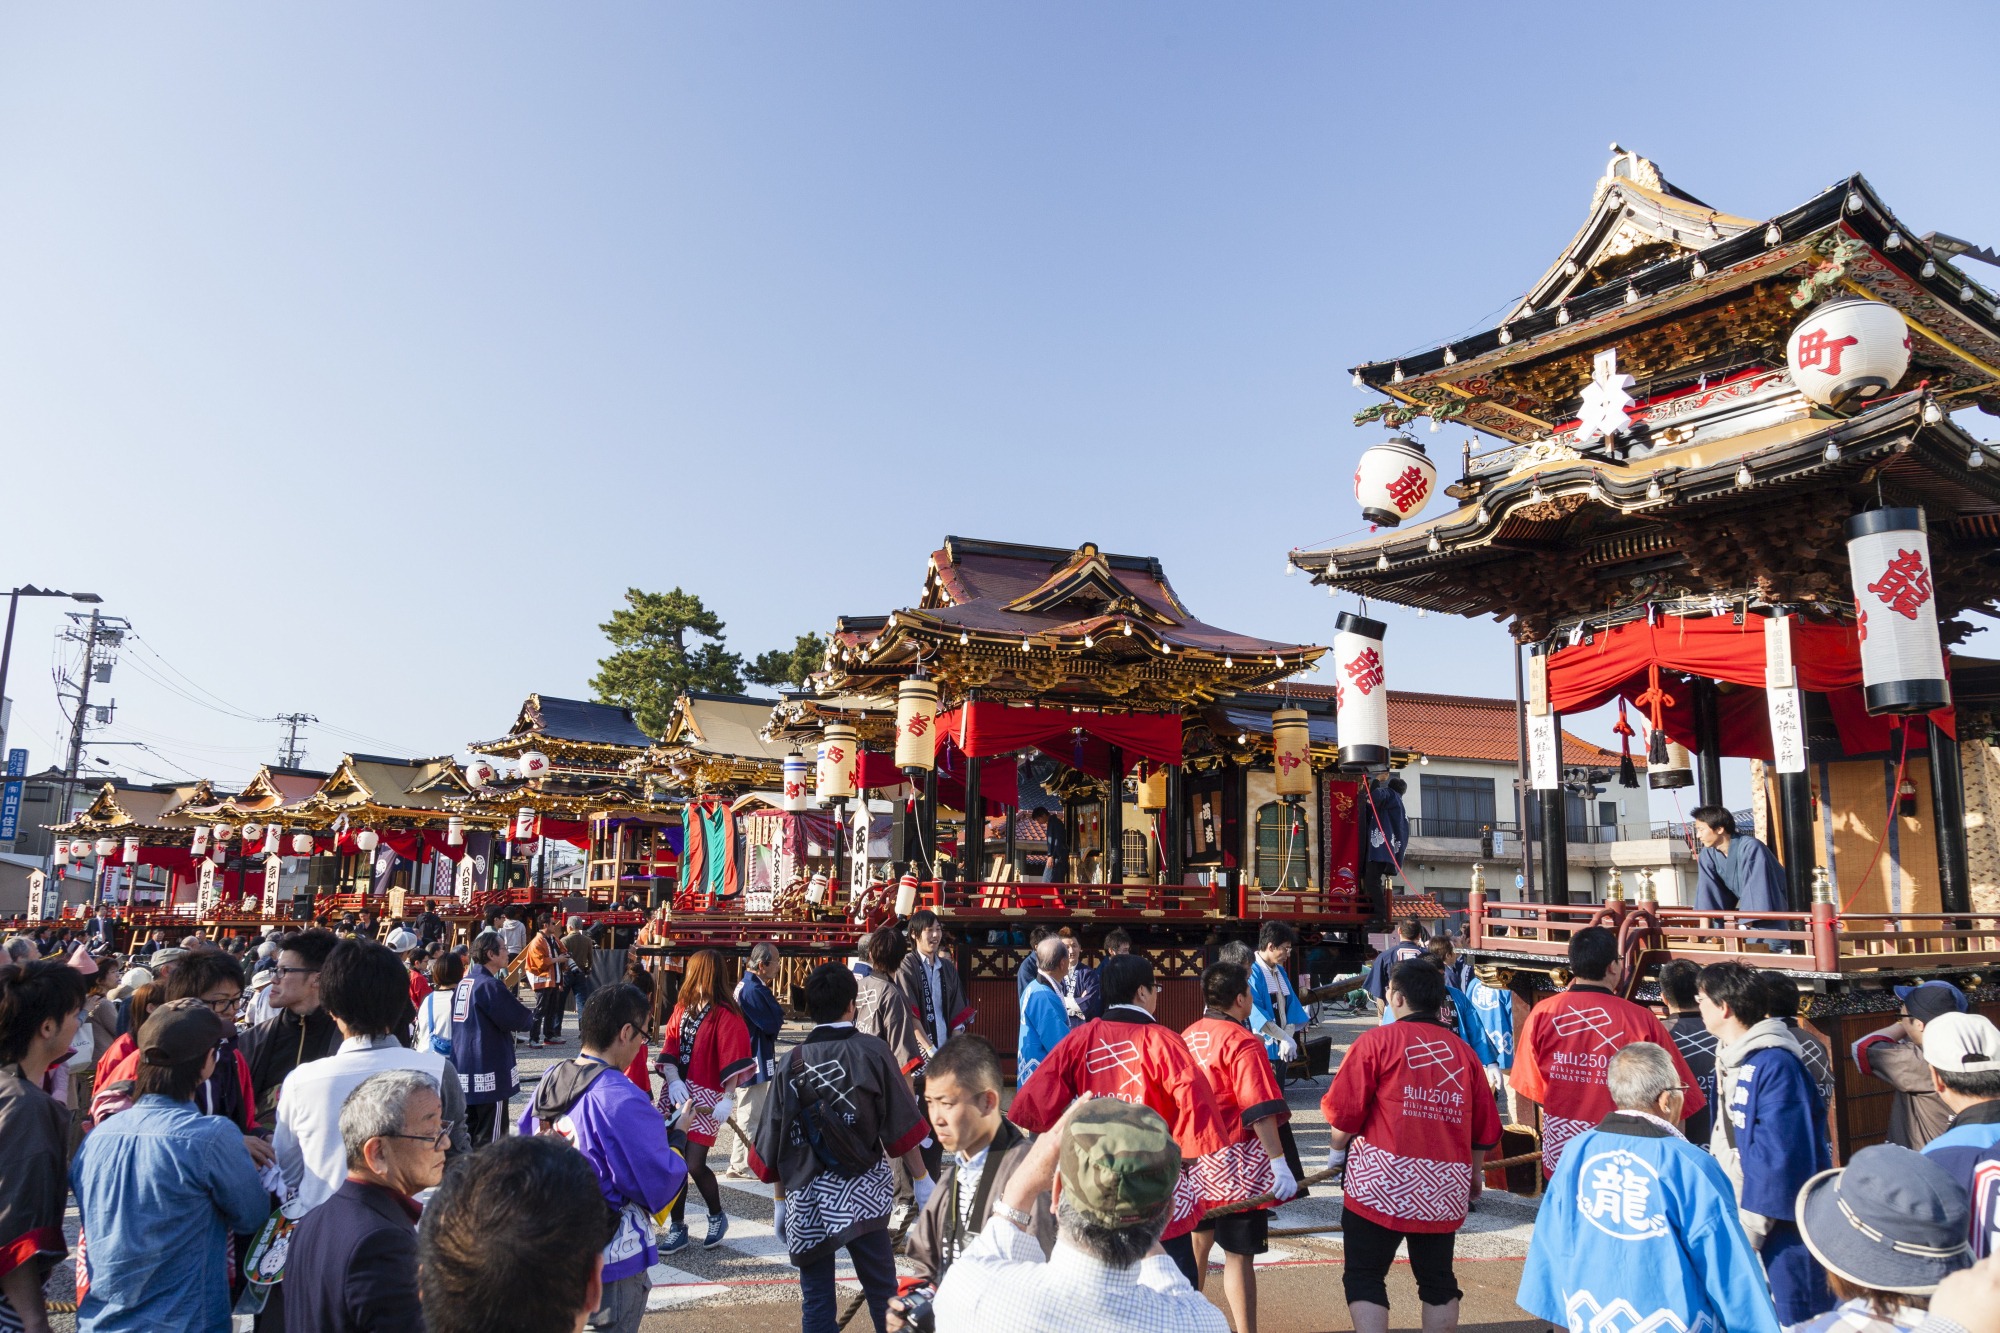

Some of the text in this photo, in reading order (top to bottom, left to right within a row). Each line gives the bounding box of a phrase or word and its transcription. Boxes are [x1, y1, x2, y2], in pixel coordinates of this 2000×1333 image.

[1798, 328, 1859, 375] 町
[1278, 751, 1301, 777] 中
[1553, 1050, 1614, 1069] 曳山250
[1549, 1072, 1592, 1084] KOMATSU
[1592, 1163, 1651, 1232] 龍
